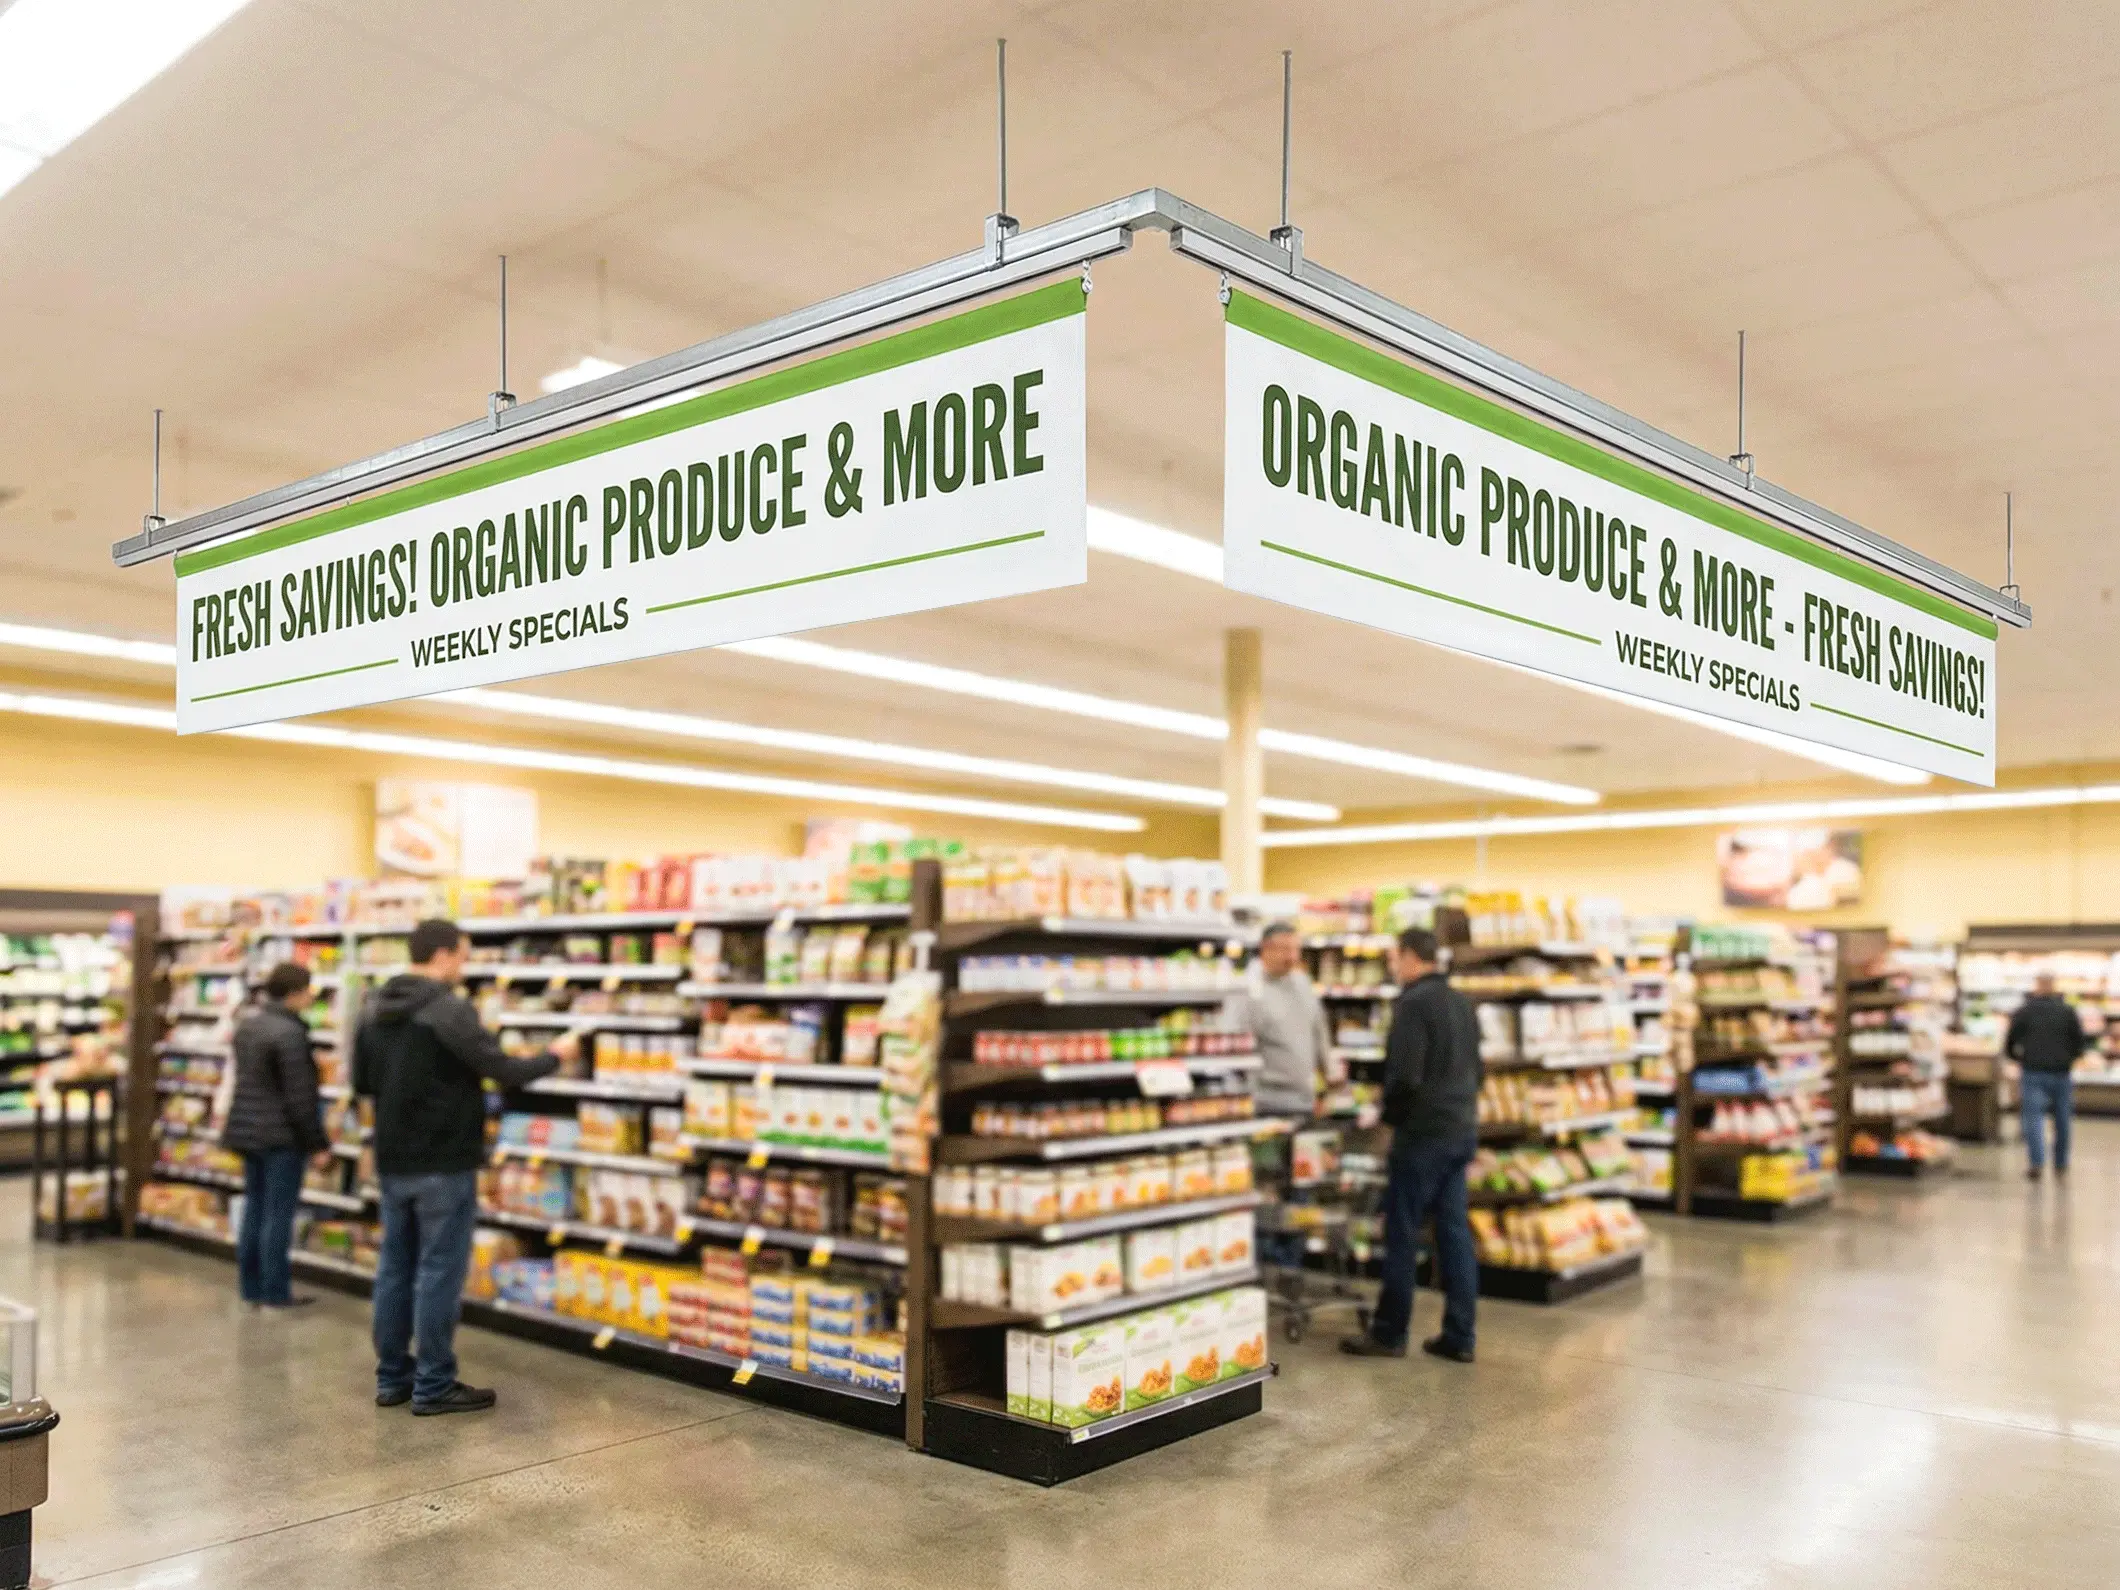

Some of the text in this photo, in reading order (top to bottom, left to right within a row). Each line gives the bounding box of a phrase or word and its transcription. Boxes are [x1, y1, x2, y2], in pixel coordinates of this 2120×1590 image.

[192, 368, 1045, 663] FRESH SAVINGS! ORGANIC PRODUCE & MORE
[1262, 383, 1466, 547] ORGANIC
[1480, 466, 1648, 609] PRODUCE
[1658, 537, 1684, 621] &
[1693, 549, 1776, 652] MORE
[1804, 591, 1882, 685] FRESH
[1888, 625, 1986, 720] SAVINGS!
[410, 596, 630, 668] WEEKLY SPECIALS
[1615, 630, 1801, 712] WEEKLY SPECIALS
